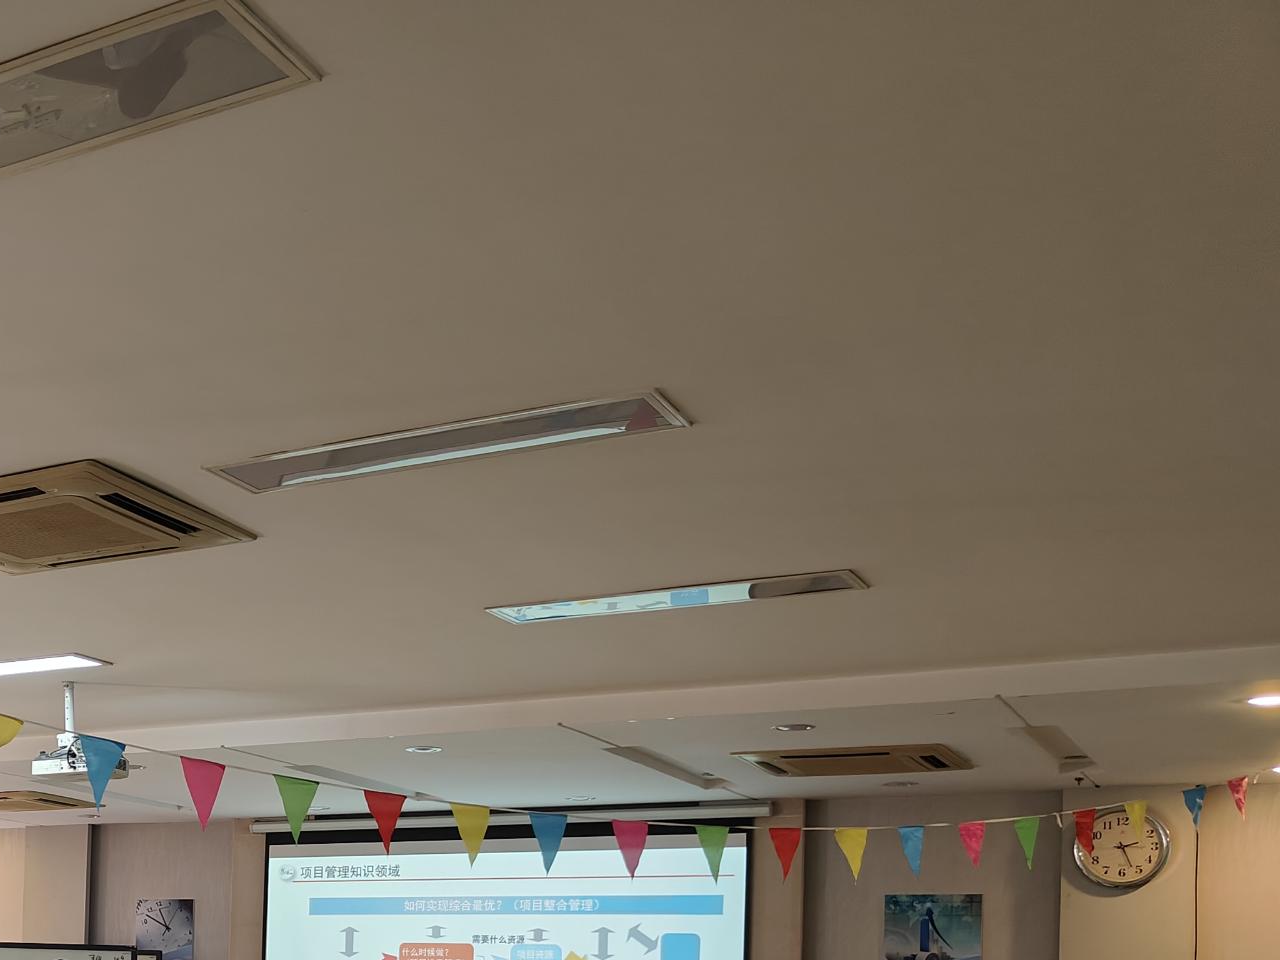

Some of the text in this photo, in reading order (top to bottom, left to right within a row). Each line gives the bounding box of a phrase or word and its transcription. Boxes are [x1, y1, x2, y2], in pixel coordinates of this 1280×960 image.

[1103, 821, 1112, 830] 11
[1116, 816, 1130, 826] 12
[1092, 830, 1102, 840] 10
[1146, 829, 1155, 839] 2
[1150, 842, 1159, 851] 3
[1091, 856, 1100, 865] 8
[1144, 855, 1152, 864] 4
[300, 864, 401, 879] 项目管理知识领域
[1102, 866, 1110, 875] 7
[1118, 868, 1126, 877] 6
[1135, 865, 1143, 874] 5
[472, 934, 526, 945] 需要什么资源
